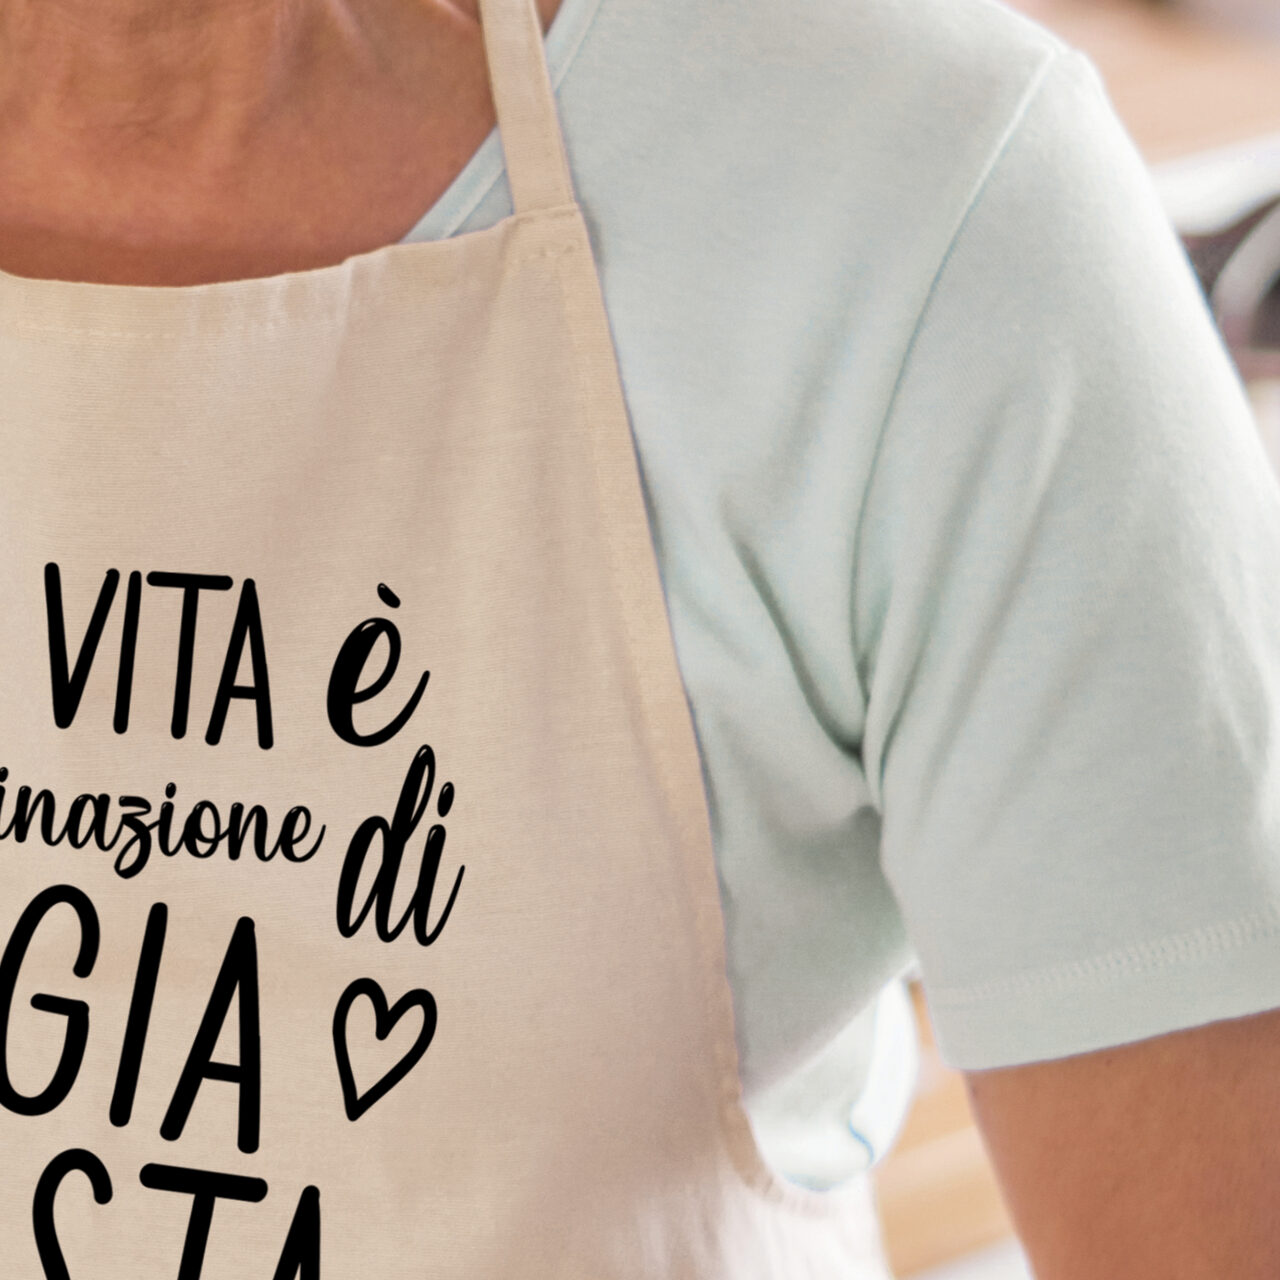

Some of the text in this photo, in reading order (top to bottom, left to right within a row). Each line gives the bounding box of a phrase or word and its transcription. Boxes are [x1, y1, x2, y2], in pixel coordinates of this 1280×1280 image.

[43, 561, 275, 751] VITA
[325, 582, 431, 748] è
[335, 743, 466, 948] di
